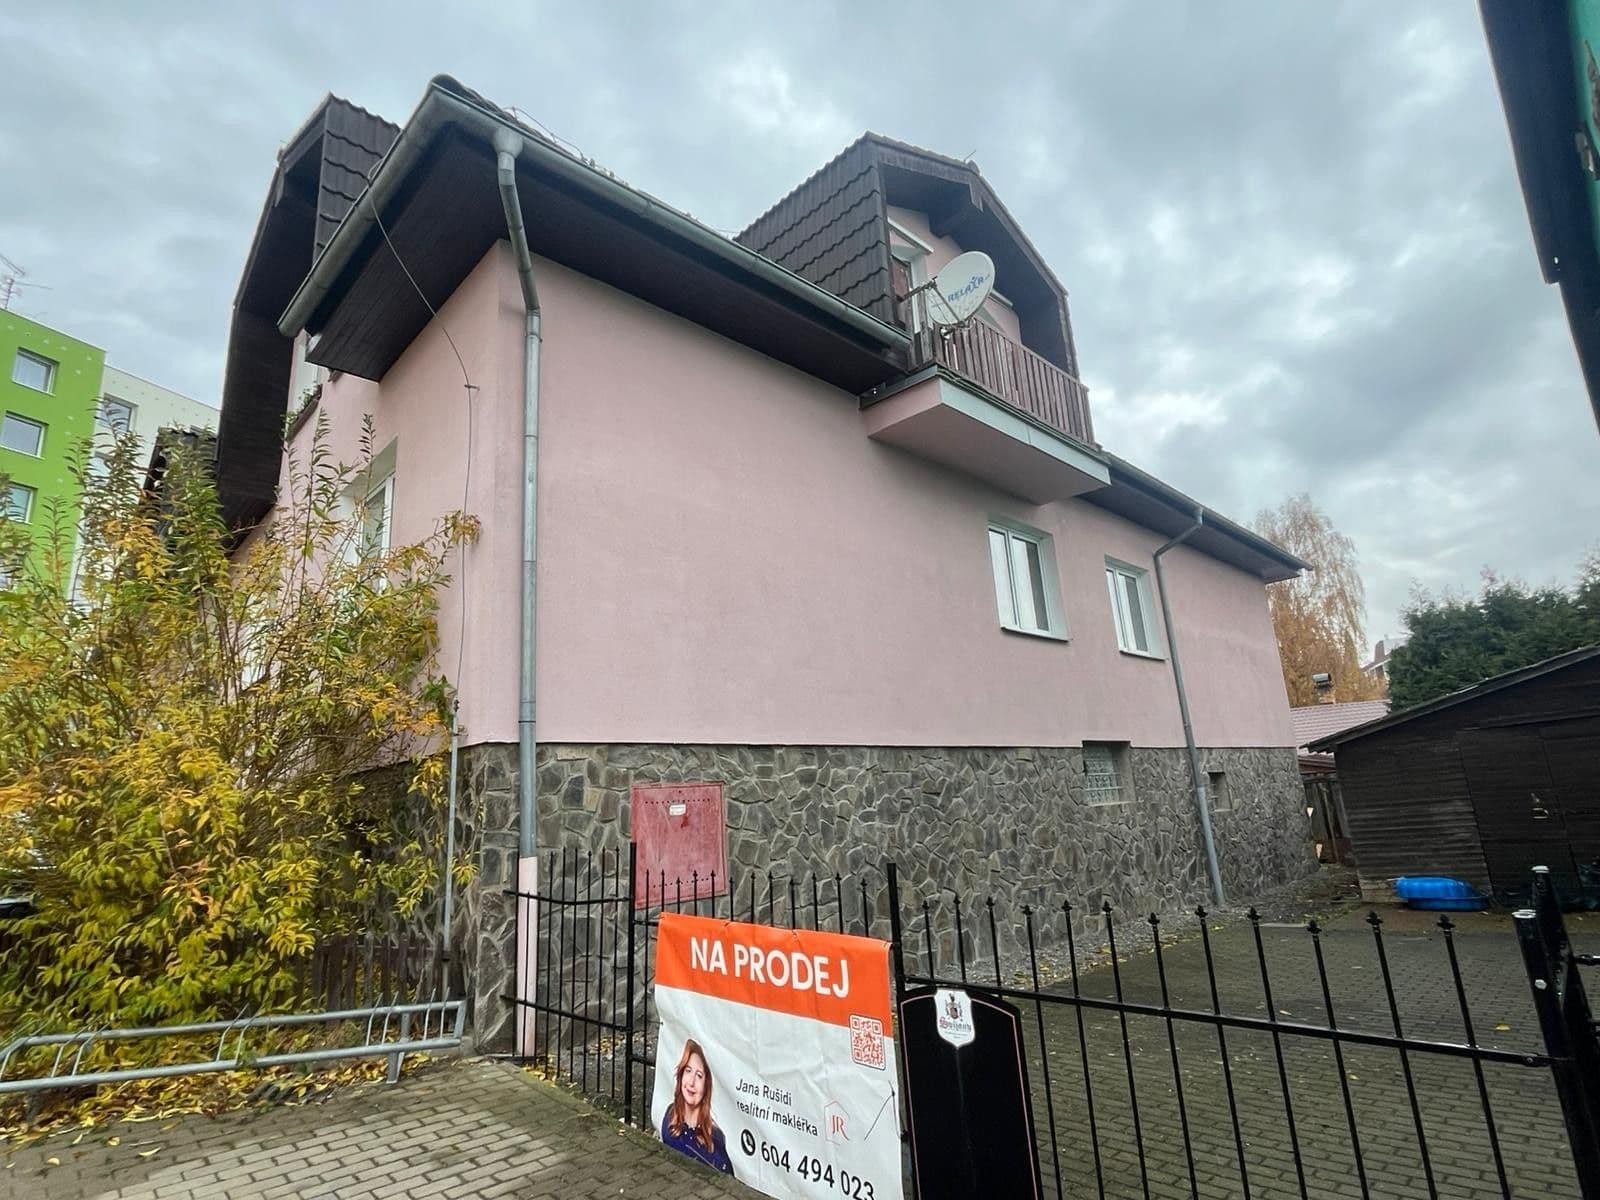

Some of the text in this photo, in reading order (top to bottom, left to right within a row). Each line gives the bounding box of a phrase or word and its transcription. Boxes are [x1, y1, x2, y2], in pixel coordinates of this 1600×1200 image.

[690, 937, 849, 998] NA PRODEJ
[735, 1078, 792, 1106] Jana Rušidi
[736, 1100, 771, 1121] realitní
[761, 1141, 875, 1200] 604 494 023
